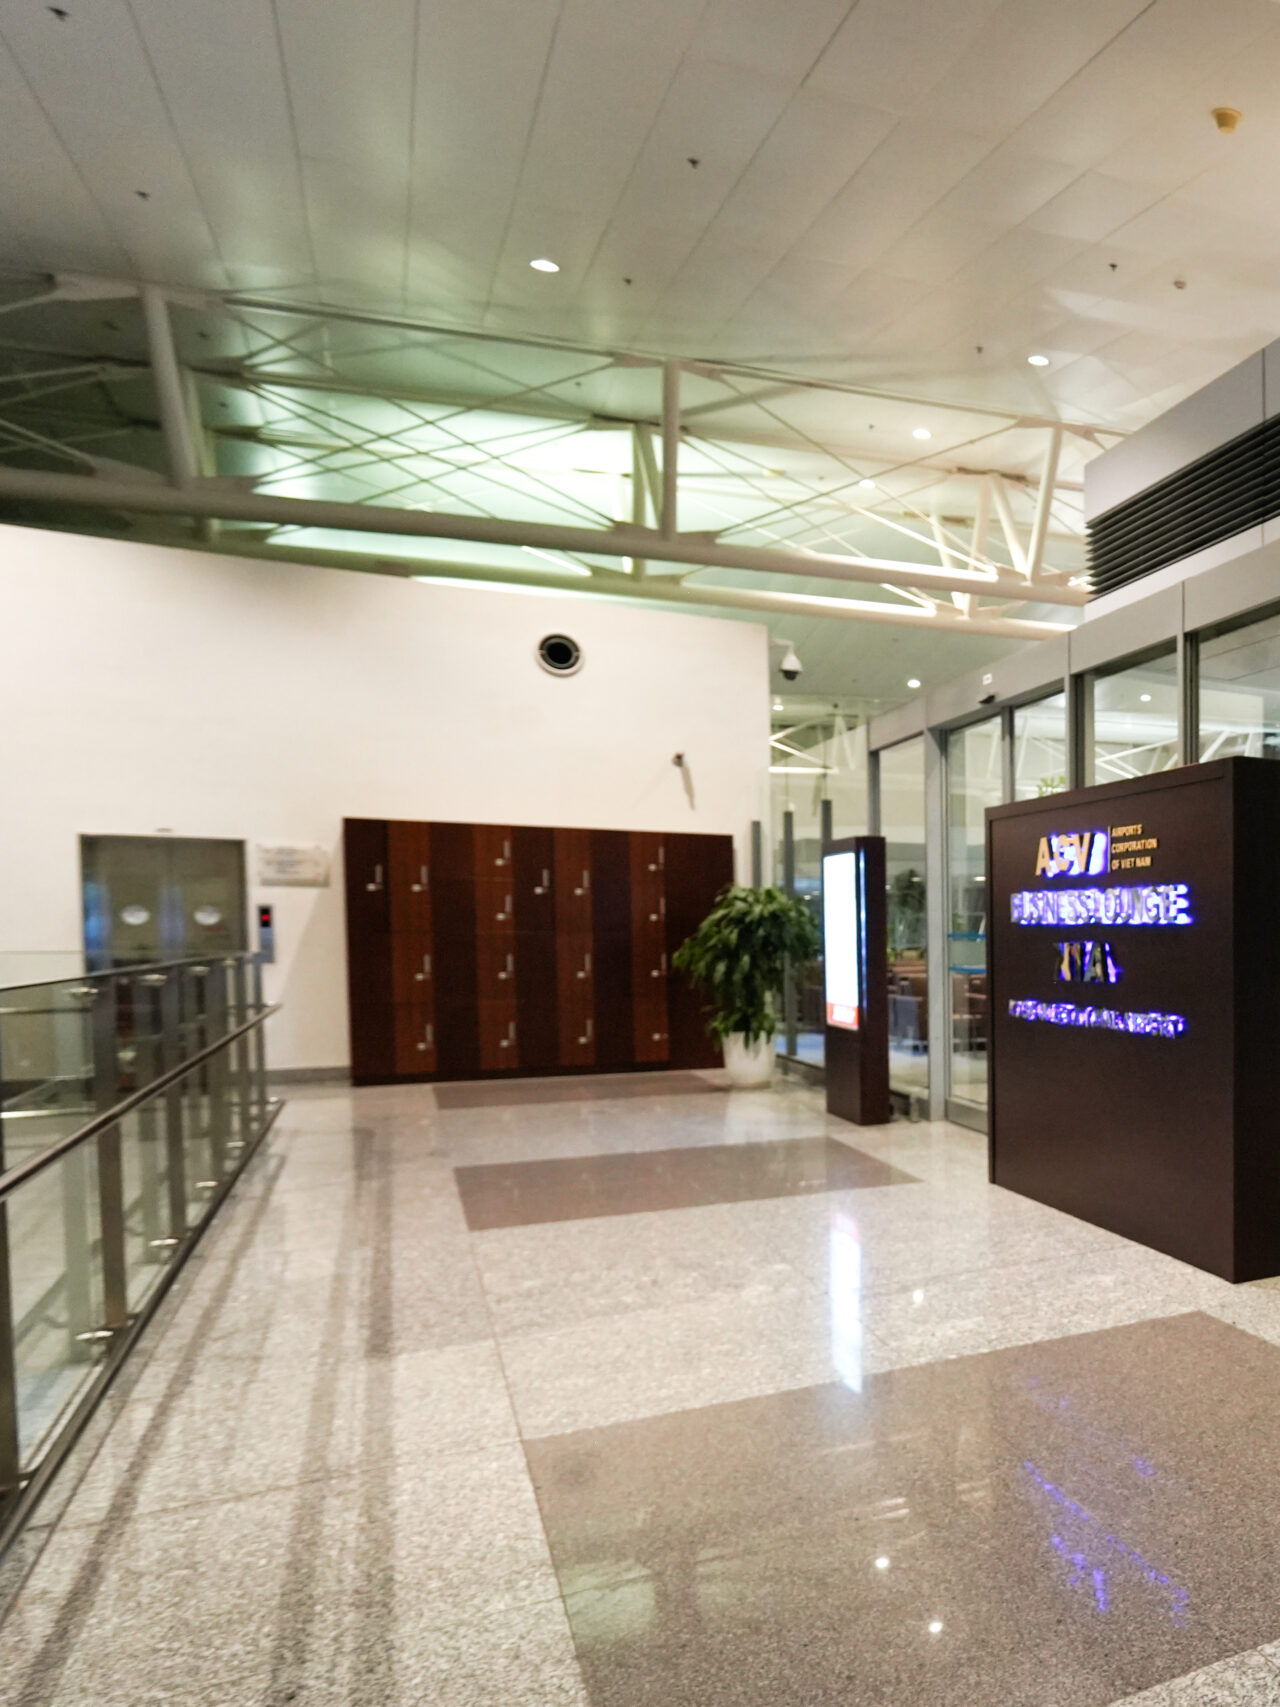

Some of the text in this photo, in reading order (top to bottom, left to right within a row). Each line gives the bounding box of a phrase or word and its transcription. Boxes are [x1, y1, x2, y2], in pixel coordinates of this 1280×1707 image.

[1111, 824, 1143, 838] AIRPORTS
[1111, 838, 1158, 854] CORPORATION
[1111, 859, 1120, 870] OF
[1121, 858, 1136, 869] VIET
